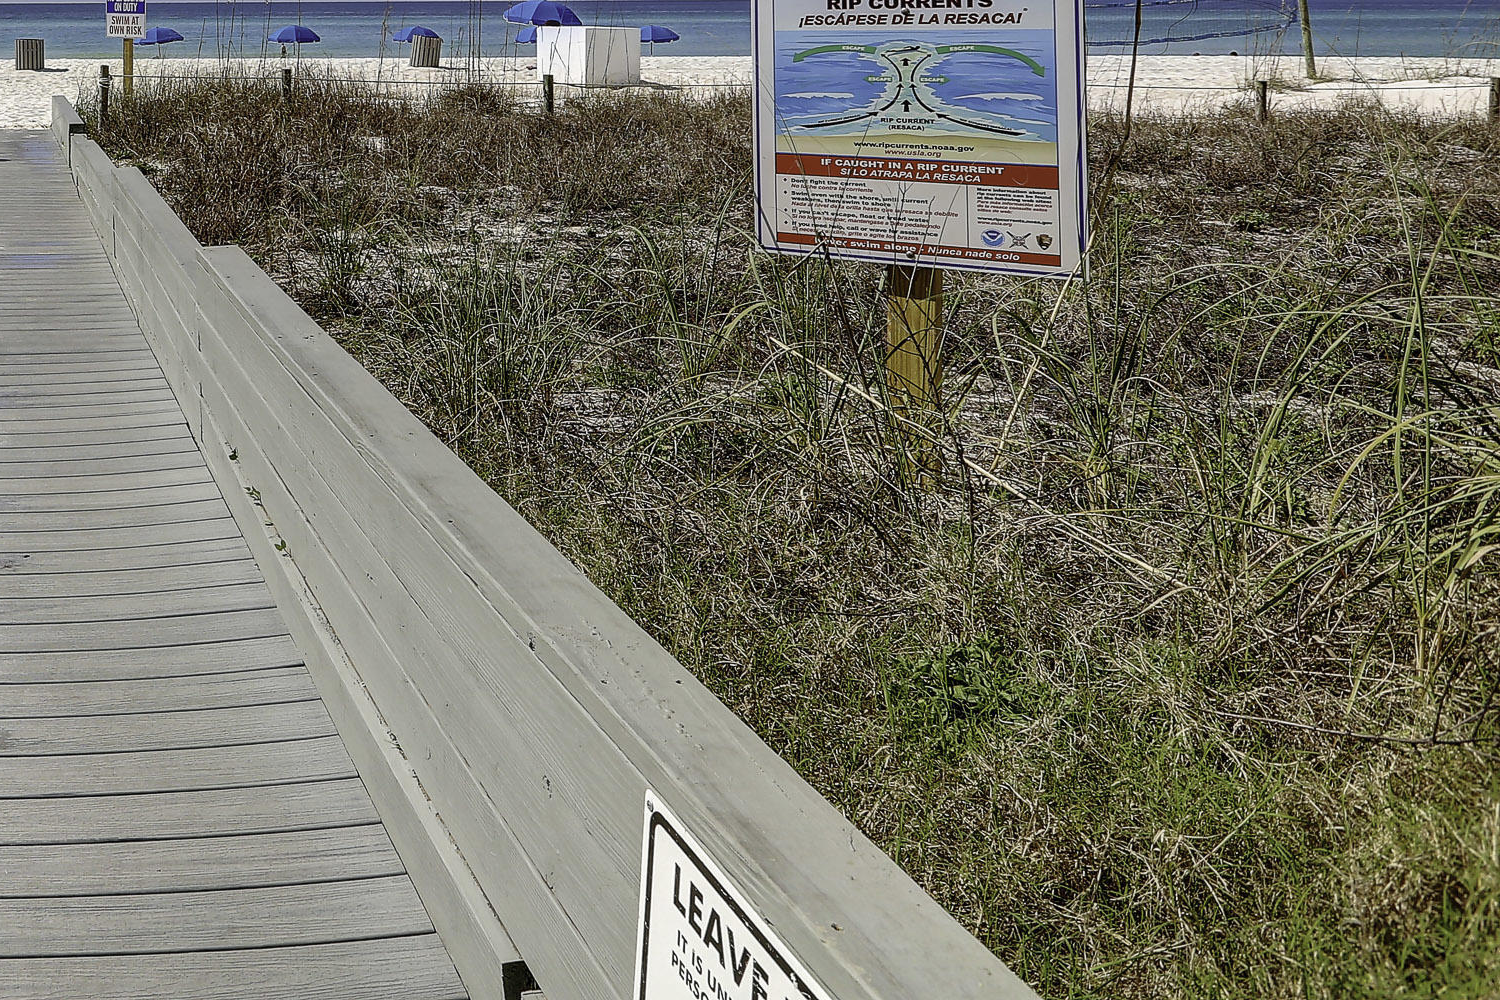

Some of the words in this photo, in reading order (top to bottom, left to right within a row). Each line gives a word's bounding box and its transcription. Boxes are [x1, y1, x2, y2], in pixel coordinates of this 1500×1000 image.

[114, 2, 122, 12] ON
[122, 2, 138, 12] DUTY
[111, 16, 130, 25] SWIM
[131, 16, 140, 25] AT
[798, 12, 888, 28] ¡ESCÁPESE
[892, 14, 915, 25] DE
[918, 13, 940, 25] LA
[109, 26, 125, 35] OWN
[126, 26, 142, 36] RISK
[854, 141, 974, 153] www.ripcurrents.noaa.gov
[884, 150, 942, 158] www.usla.org
[834, 160, 885, 169] CAUGHT
[904, 162, 914, 170] A
[917, 163, 938, 171] RIP
[942, 164, 1005, 175] CURRENT
[870, 170, 913, 179] ATRAPA
[916, 172, 931, 180] LA
[933, 173, 981, 182] RESACA
[850, 240, 880, 249] swim
[884, 243, 916, 252] alone
[928, 246, 962, 256] Nunca
[965, 250, 993, 258] nade
[995, 253, 1020, 261] solo
[677, 930, 688, 954] IT
[692, 948, 702, 976] IS
